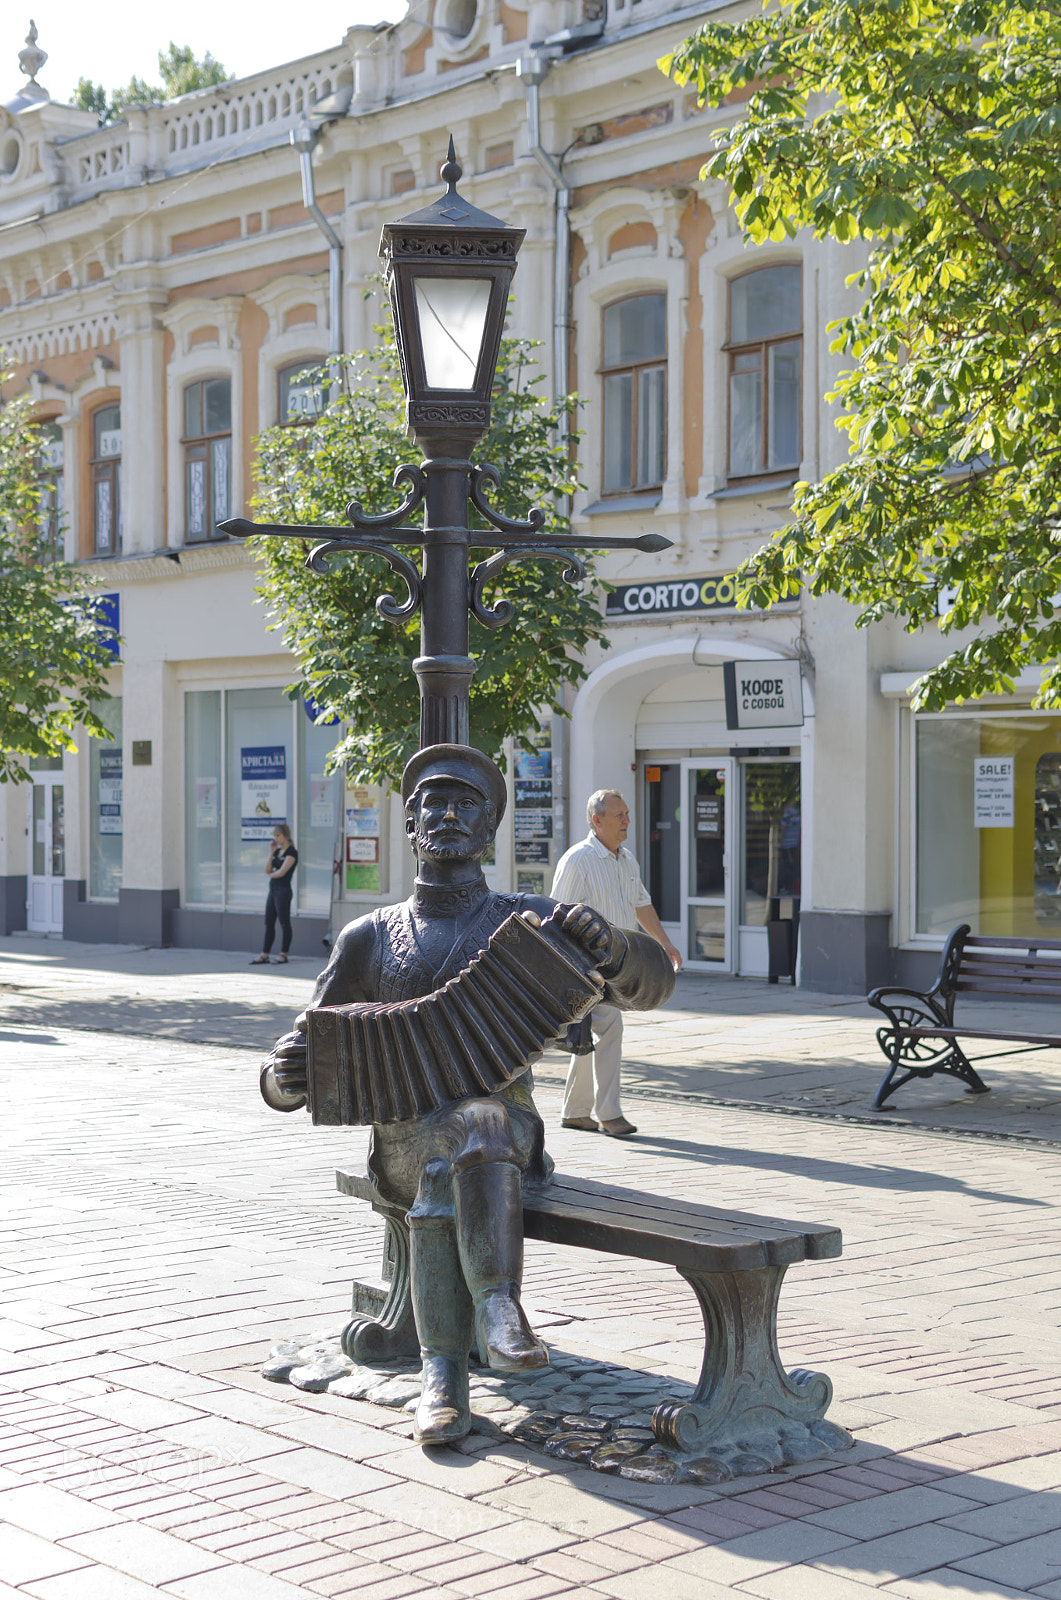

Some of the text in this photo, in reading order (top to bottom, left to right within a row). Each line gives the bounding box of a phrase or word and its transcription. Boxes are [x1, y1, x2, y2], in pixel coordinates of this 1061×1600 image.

[741, 679, 783, 696] КОФЕ
[742, 696, 784, 710] С СОБОЙ
[242, 755, 285, 767] КРИСТАЛЛ
[979, 764, 1011, 775] SALE!
